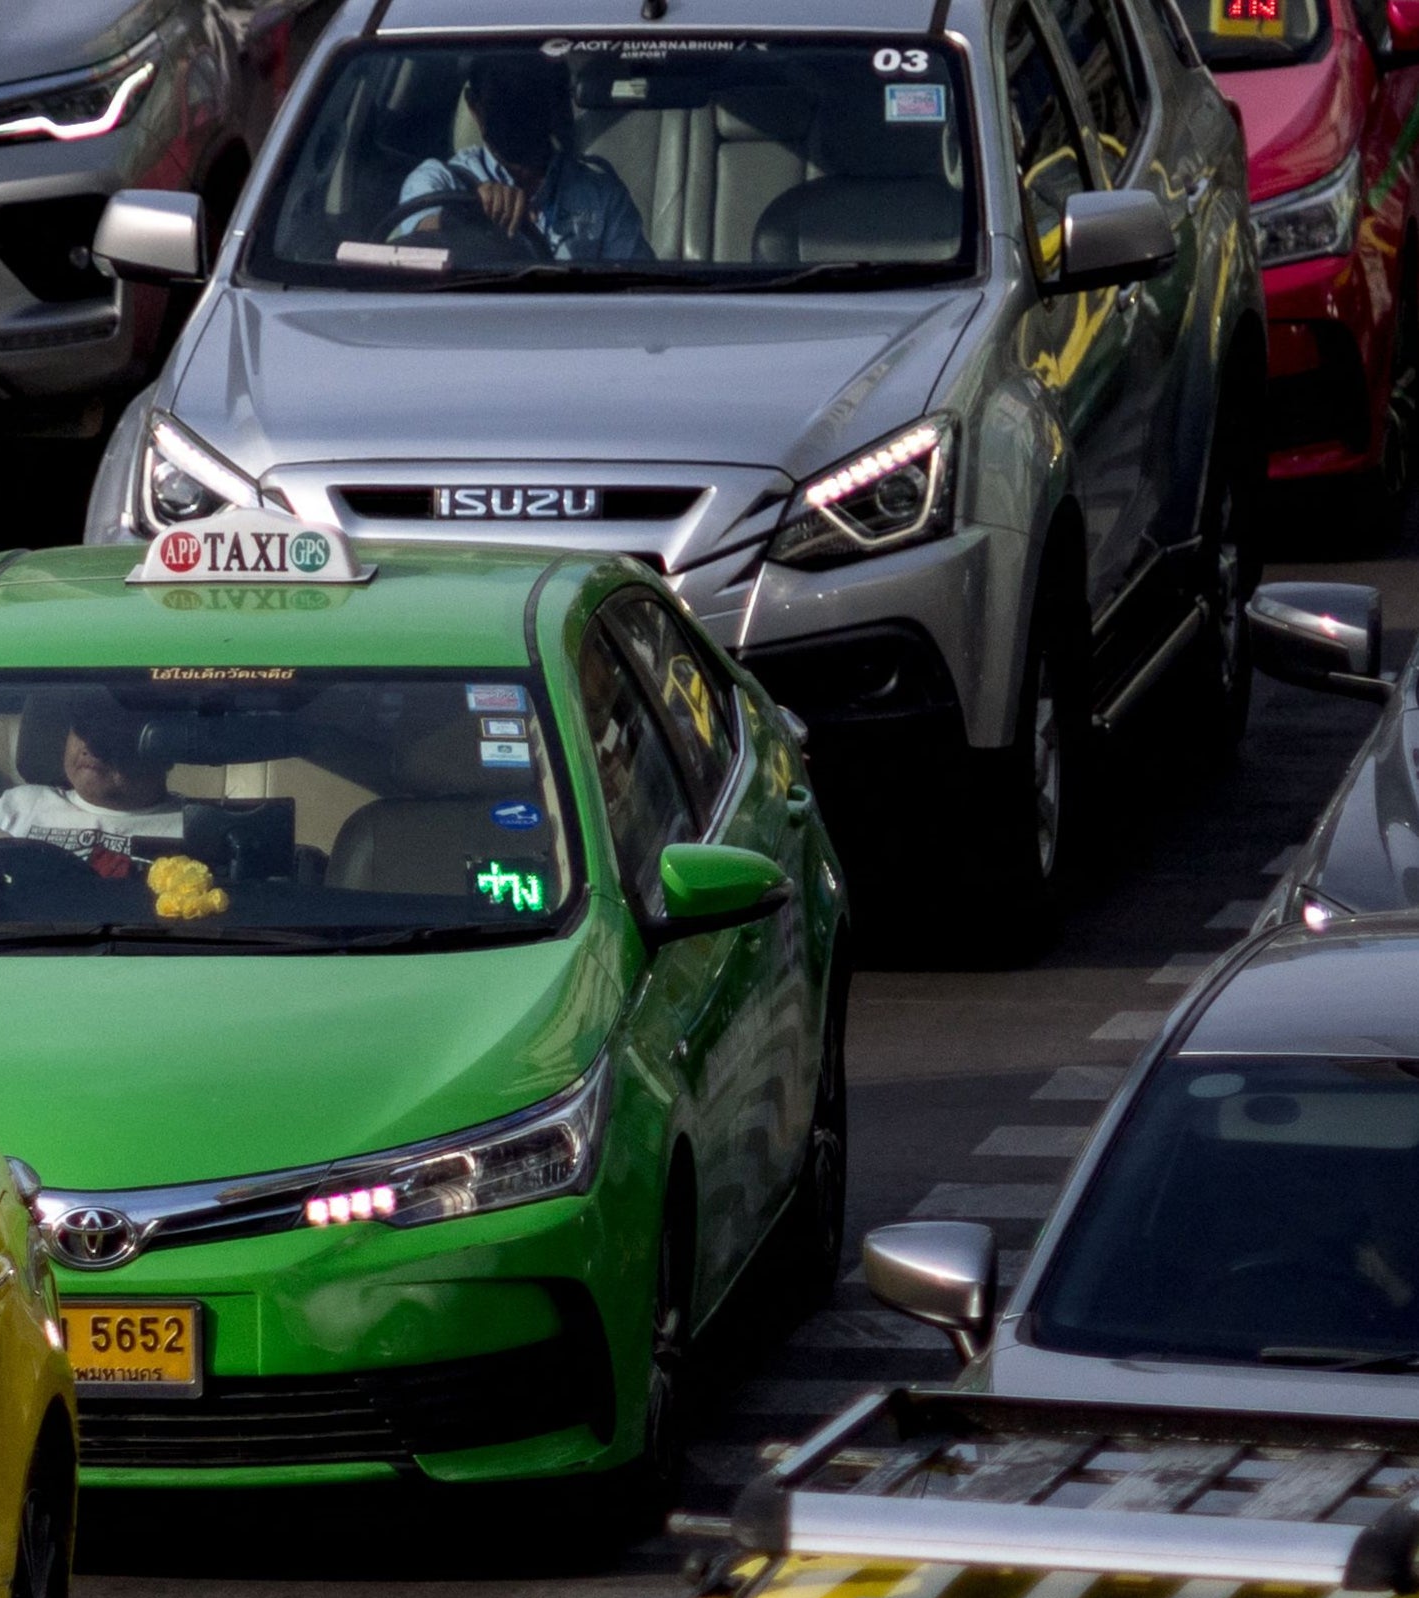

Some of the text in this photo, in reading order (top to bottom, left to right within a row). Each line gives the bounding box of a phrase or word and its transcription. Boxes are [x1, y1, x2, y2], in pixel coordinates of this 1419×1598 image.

[873, 48, 928, 73] 03
[438, 488, 597, 517] ISUZU
[165, 532, 326, 572] APP TAXI GPS
[91, 1316, 185, 1354] 5652
